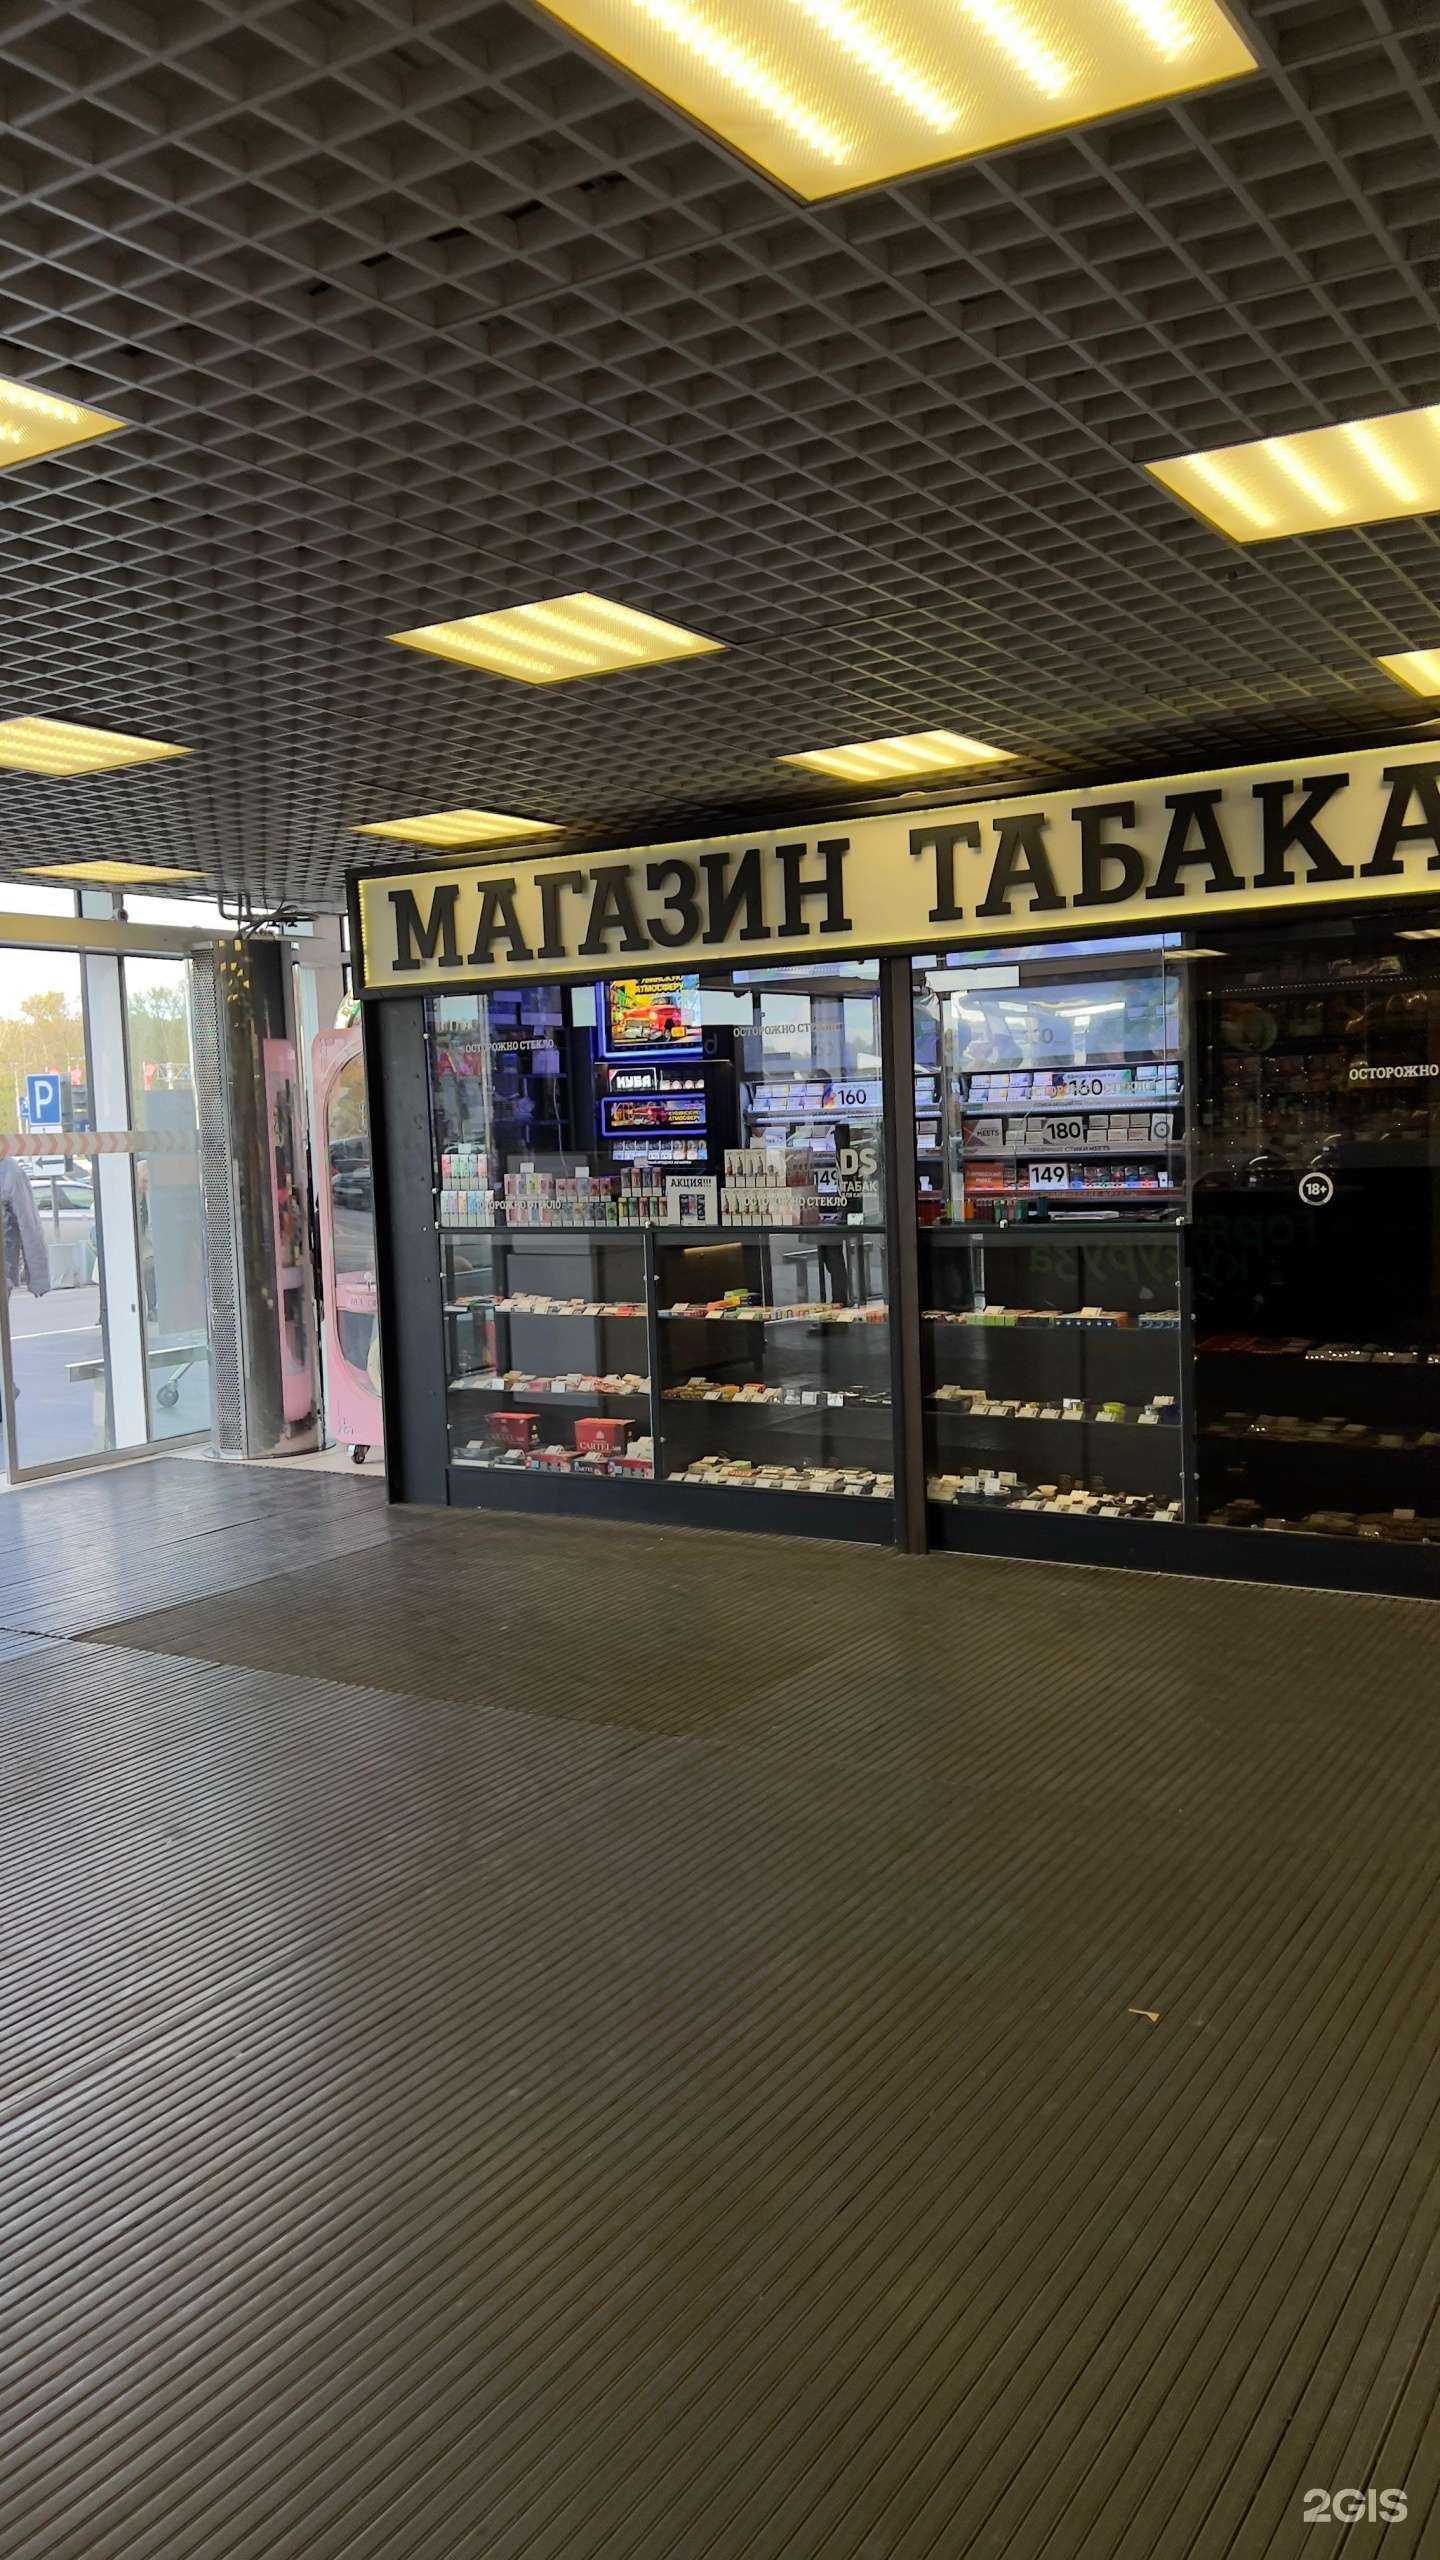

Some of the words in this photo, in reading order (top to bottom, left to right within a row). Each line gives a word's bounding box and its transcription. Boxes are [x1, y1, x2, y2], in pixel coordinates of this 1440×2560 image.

[390, 836, 853, 970] МАГАЗИН
[909, 761, 1440, 923] ТАБАКА
[519, 1039, 554, 1050] СТЕКЛО
[1350, 1064, 1439, 1080] ОСТОРОЖНО
[1068, 1079, 1103, 1096] 160
[34, 1081, 54, 1119] P
[837, 1089, 867, 1105] 160
[1047, 1121, 1081, 1140] 180
[840, 1148, 877, 1176] DS
[1031, 1166, 1066, 1184] 149
[670, 1178, 712, 1189] АКЦИЯ!!!
[842, 1180, 879, 1192] ТАБАК
[1306, 1183, 1328, 1196] 18+
[744, 1197, 805, 1207] ОСТОНО
[807, 1196, 848, 1207] СТЕКЛО
